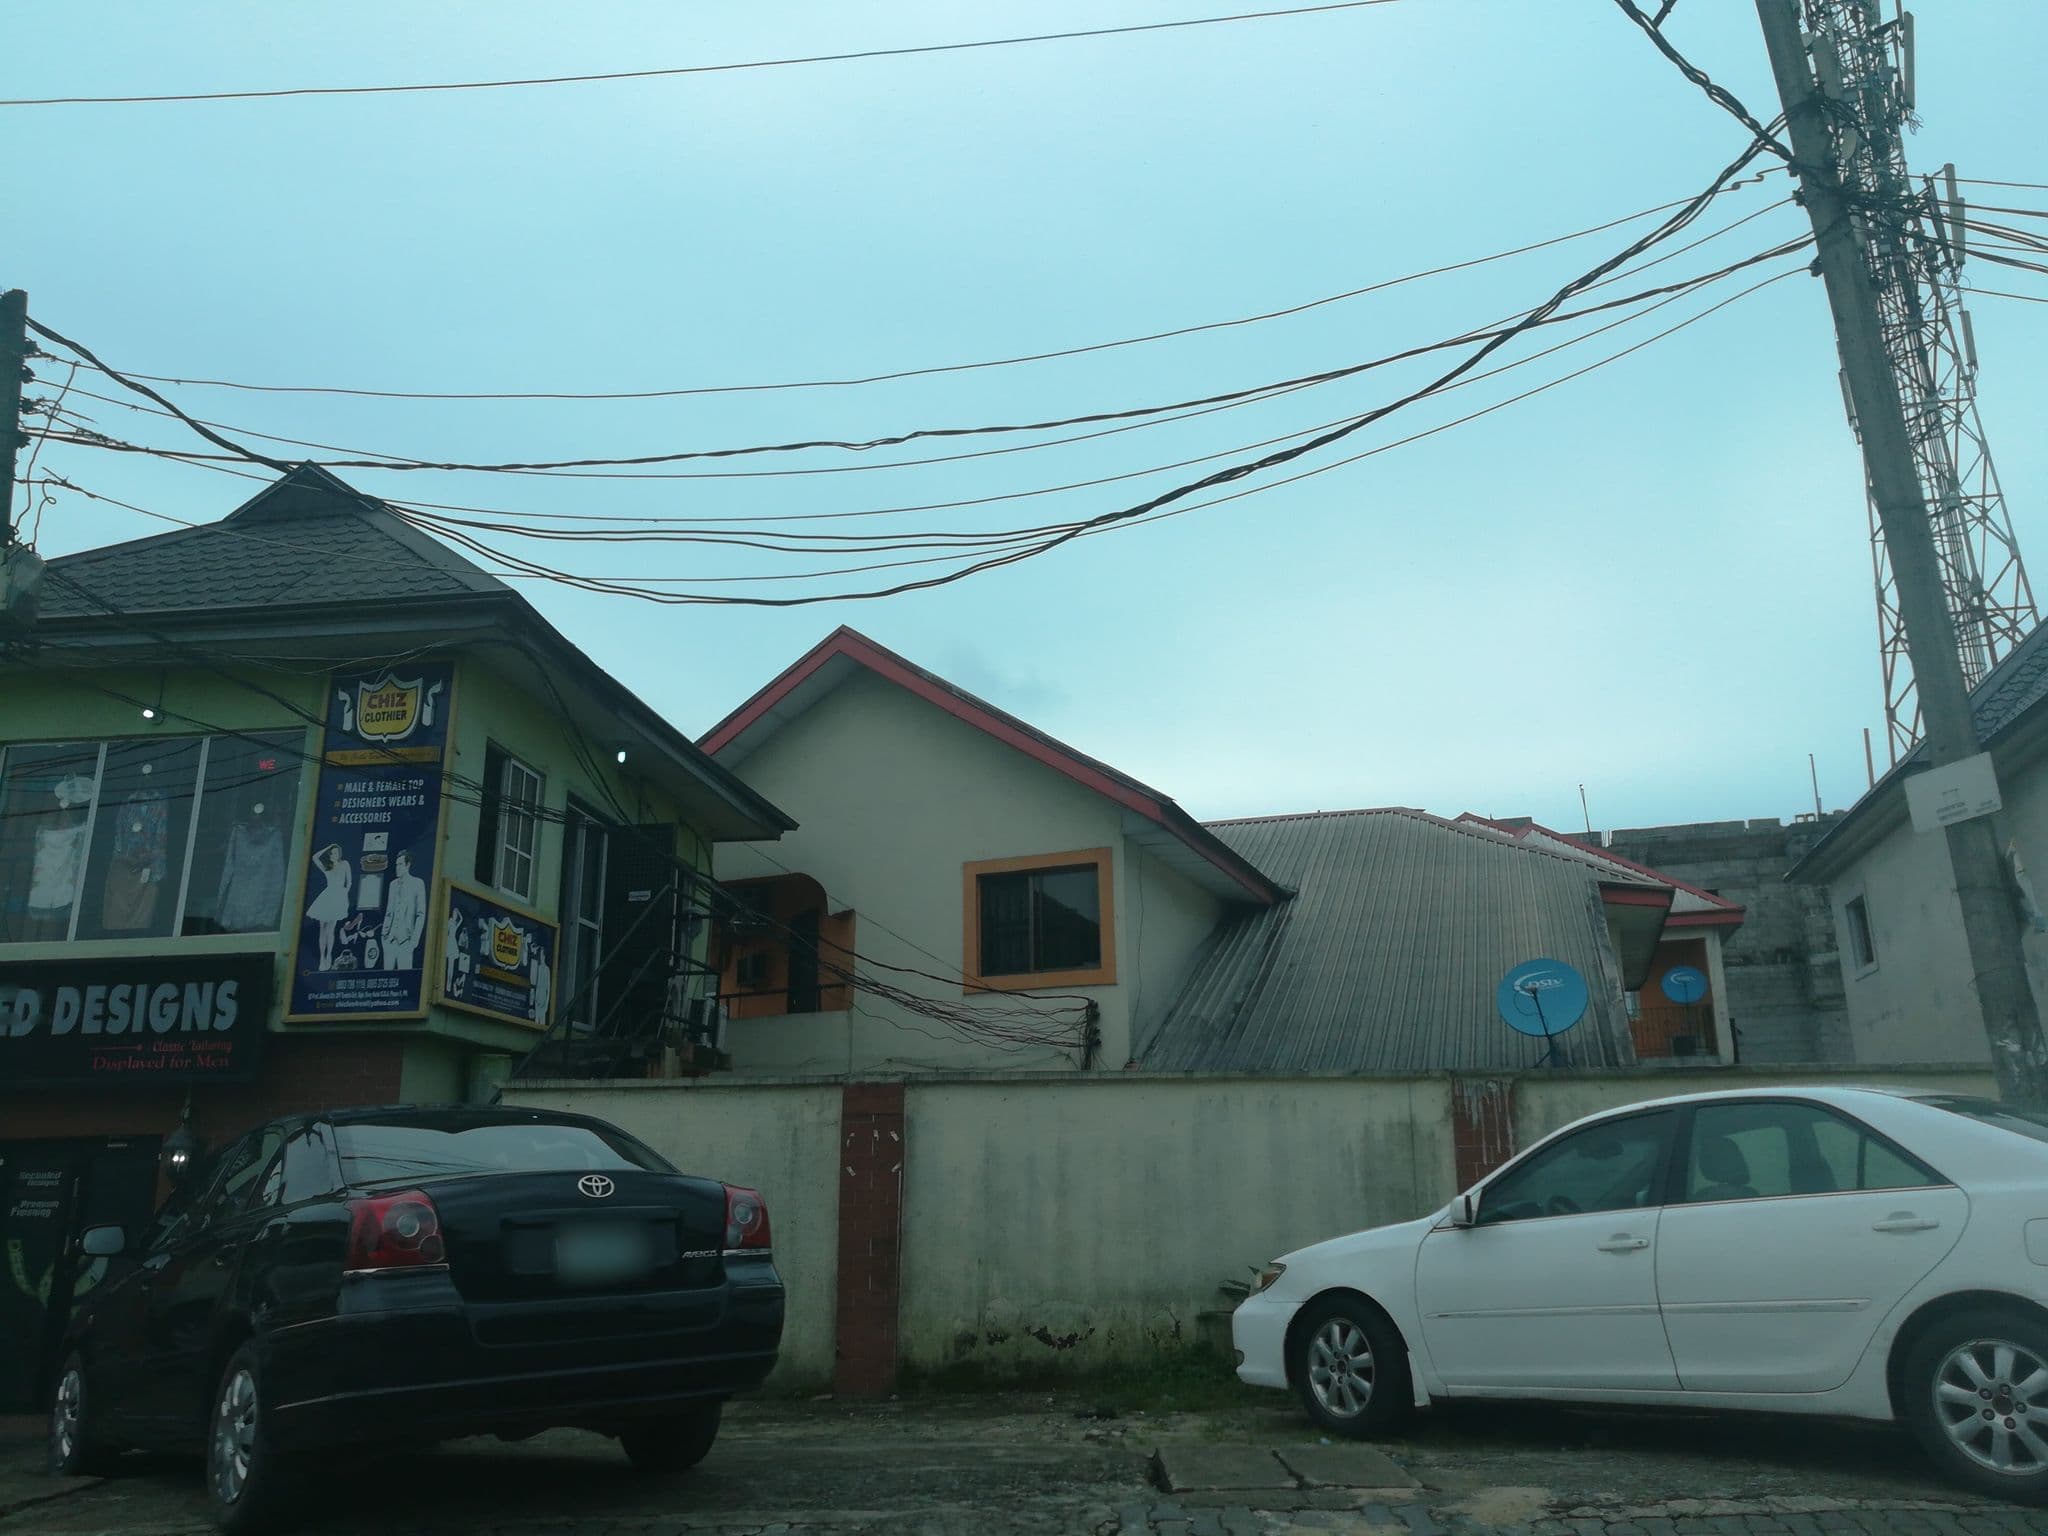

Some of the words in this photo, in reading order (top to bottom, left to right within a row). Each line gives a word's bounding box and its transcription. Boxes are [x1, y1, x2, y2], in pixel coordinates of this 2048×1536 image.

[367, 692, 407, 709] CHIZ
[364, 710, 407, 723] CLOTHIER
[344, 782, 366, 793] MALE
[367, 781, 375, 792] &
[376, 779, 406, 792] FEMALE
[408, 779, 424, 791] TOP
[342, 796, 386, 808] DESIGNERS
[388, 795, 416, 807] WEARS
[418, 794, 425, 806] &
[338, 811, 392, 824] ACCESSORIES
[499, 931, 518, 946] CHIZ
[50, 980, 240, 1035] DESIGNS
[92, 1055, 165, 1072] Displayed
[169, 1055, 192, 1070] for
[196, 1055, 231, 1070] Men
